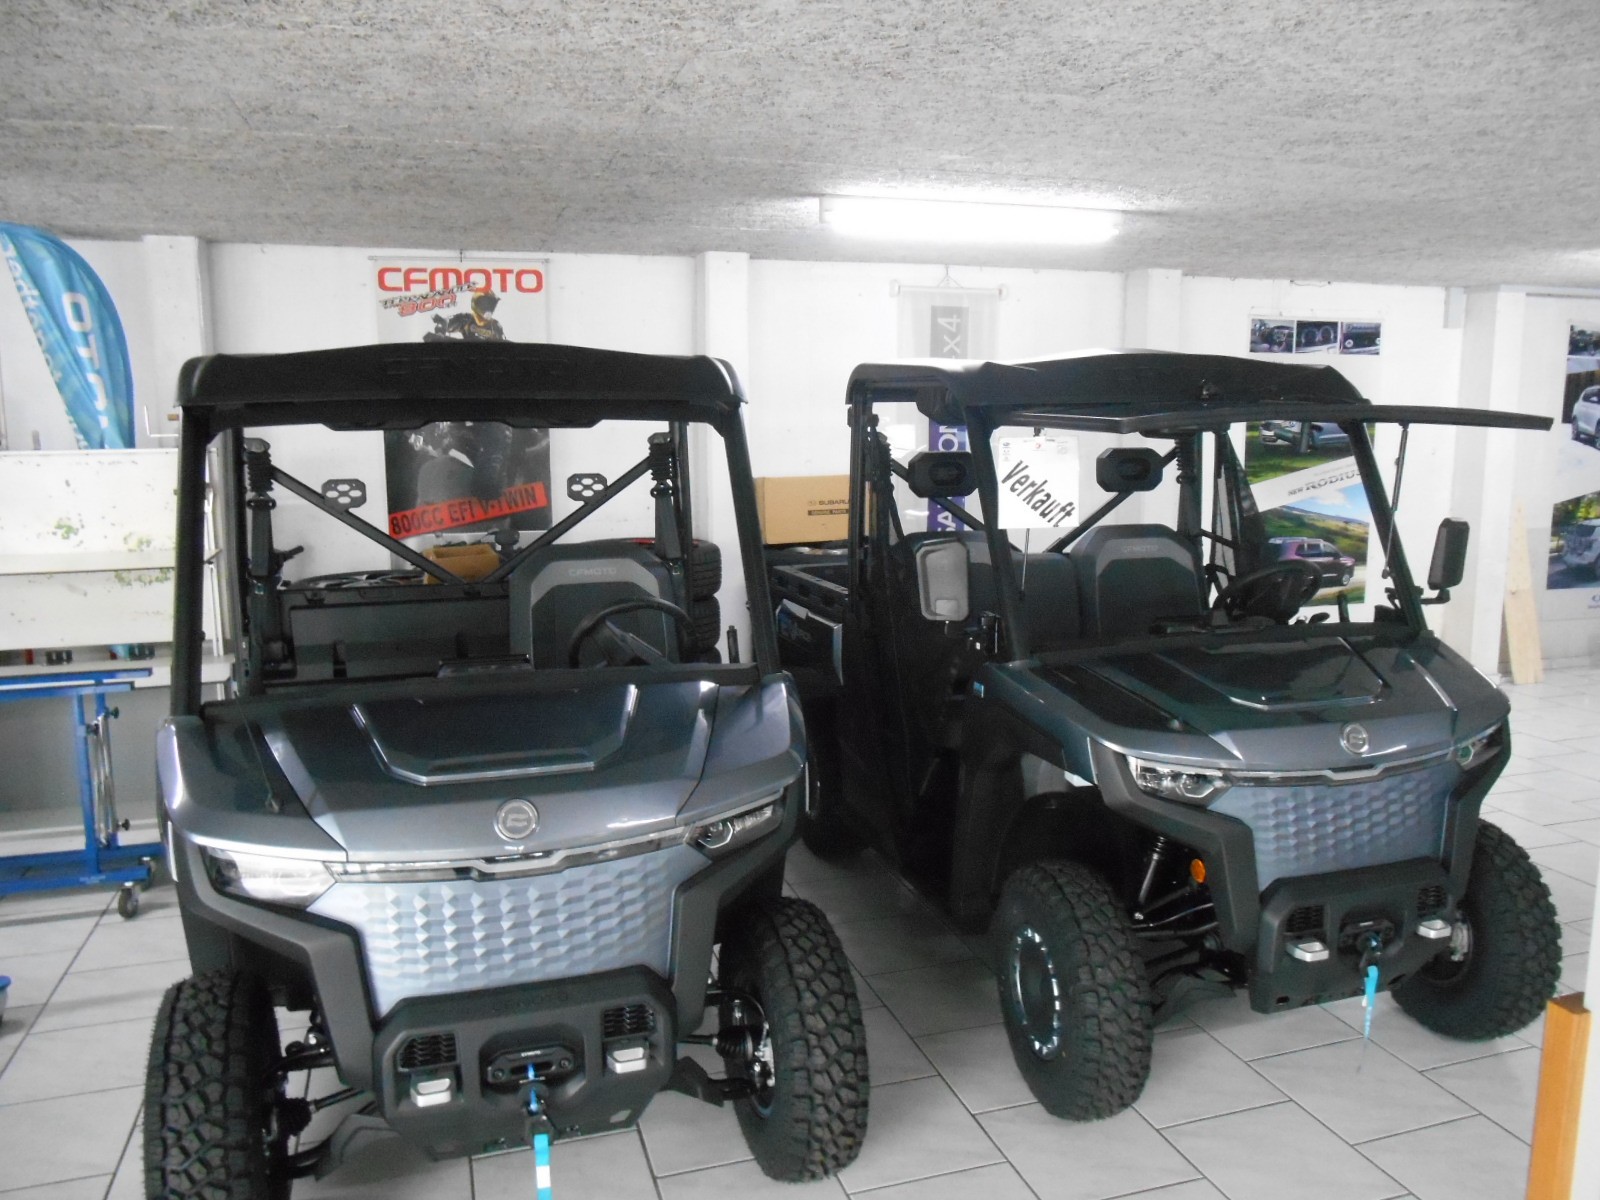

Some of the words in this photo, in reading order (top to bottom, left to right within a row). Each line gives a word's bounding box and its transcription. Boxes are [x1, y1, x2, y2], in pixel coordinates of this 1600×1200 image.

[377, 267, 544, 293] CFMOTO
[1001, 460, 1076, 527] Verkauft
[390, 507, 444, 535] 800CC
[449, 500, 477, 522] EFI
